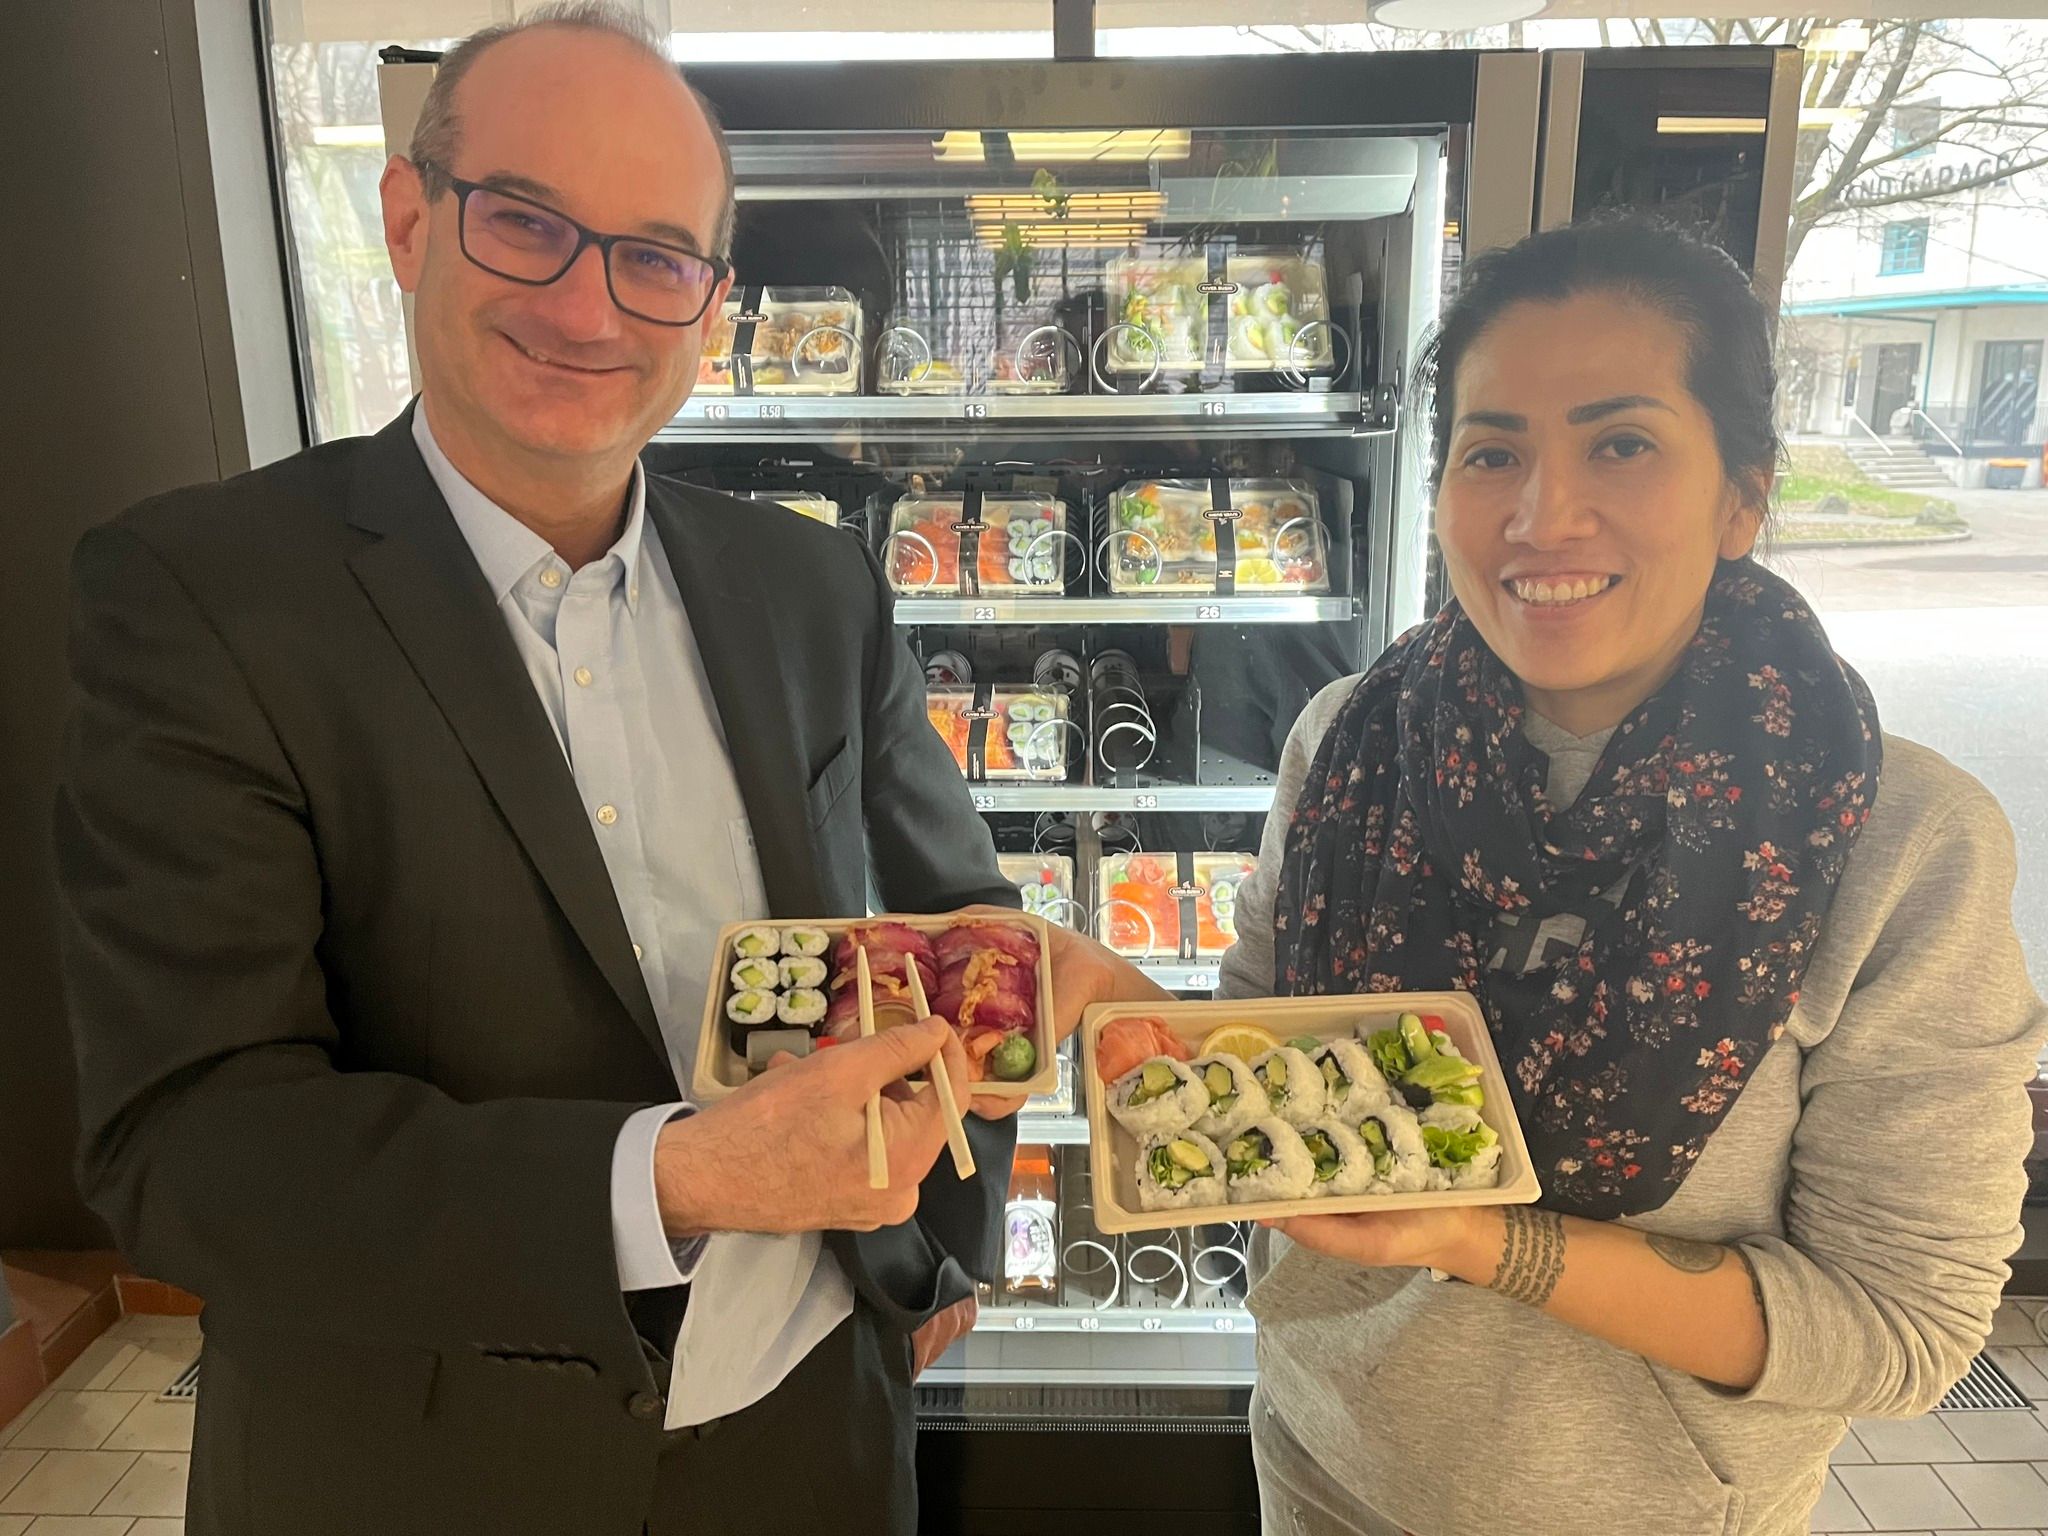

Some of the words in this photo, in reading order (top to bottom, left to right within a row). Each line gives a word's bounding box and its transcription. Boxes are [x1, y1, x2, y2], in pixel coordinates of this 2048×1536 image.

[706, 405, 727, 419] 10
[966, 404, 986, 418] 13
[1204, 402, 1225, 416] 16
[975, 607, 995, 620] 23
[1199, 606, 1220, 618] 26
[976, 796, 995, 808] 33
[1137, 795, 1157, 808] 36
[1143, 1318, 1162, 1330] 67
